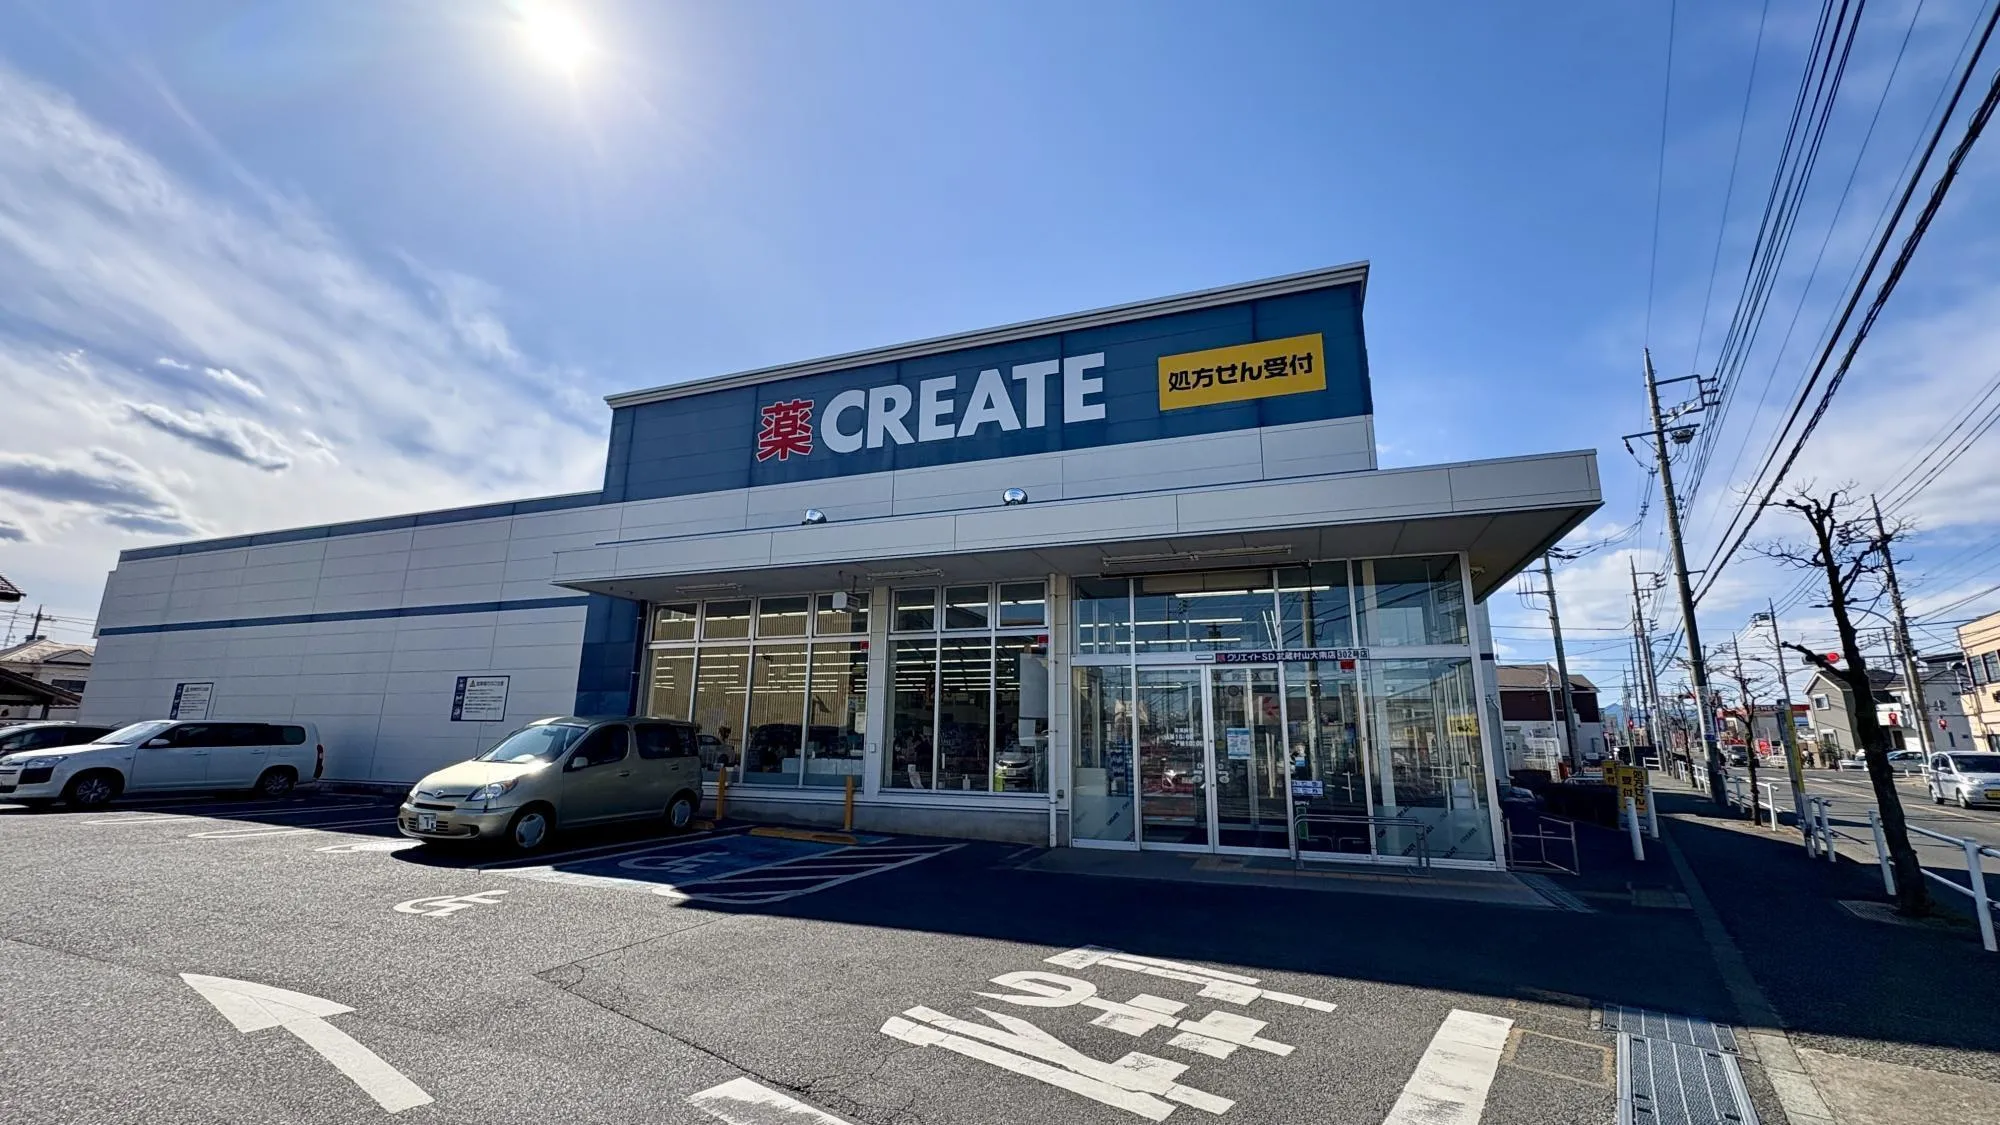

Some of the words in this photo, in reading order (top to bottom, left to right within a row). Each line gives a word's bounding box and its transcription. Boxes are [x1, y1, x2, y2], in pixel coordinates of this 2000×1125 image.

[756, 399, 814, 462] 薬
[821, 352, 1105, 453] CREATE
[1169, 353, 1313, 392] 処方せん受付
[880, 944, 1337, 1122] 止まれ
